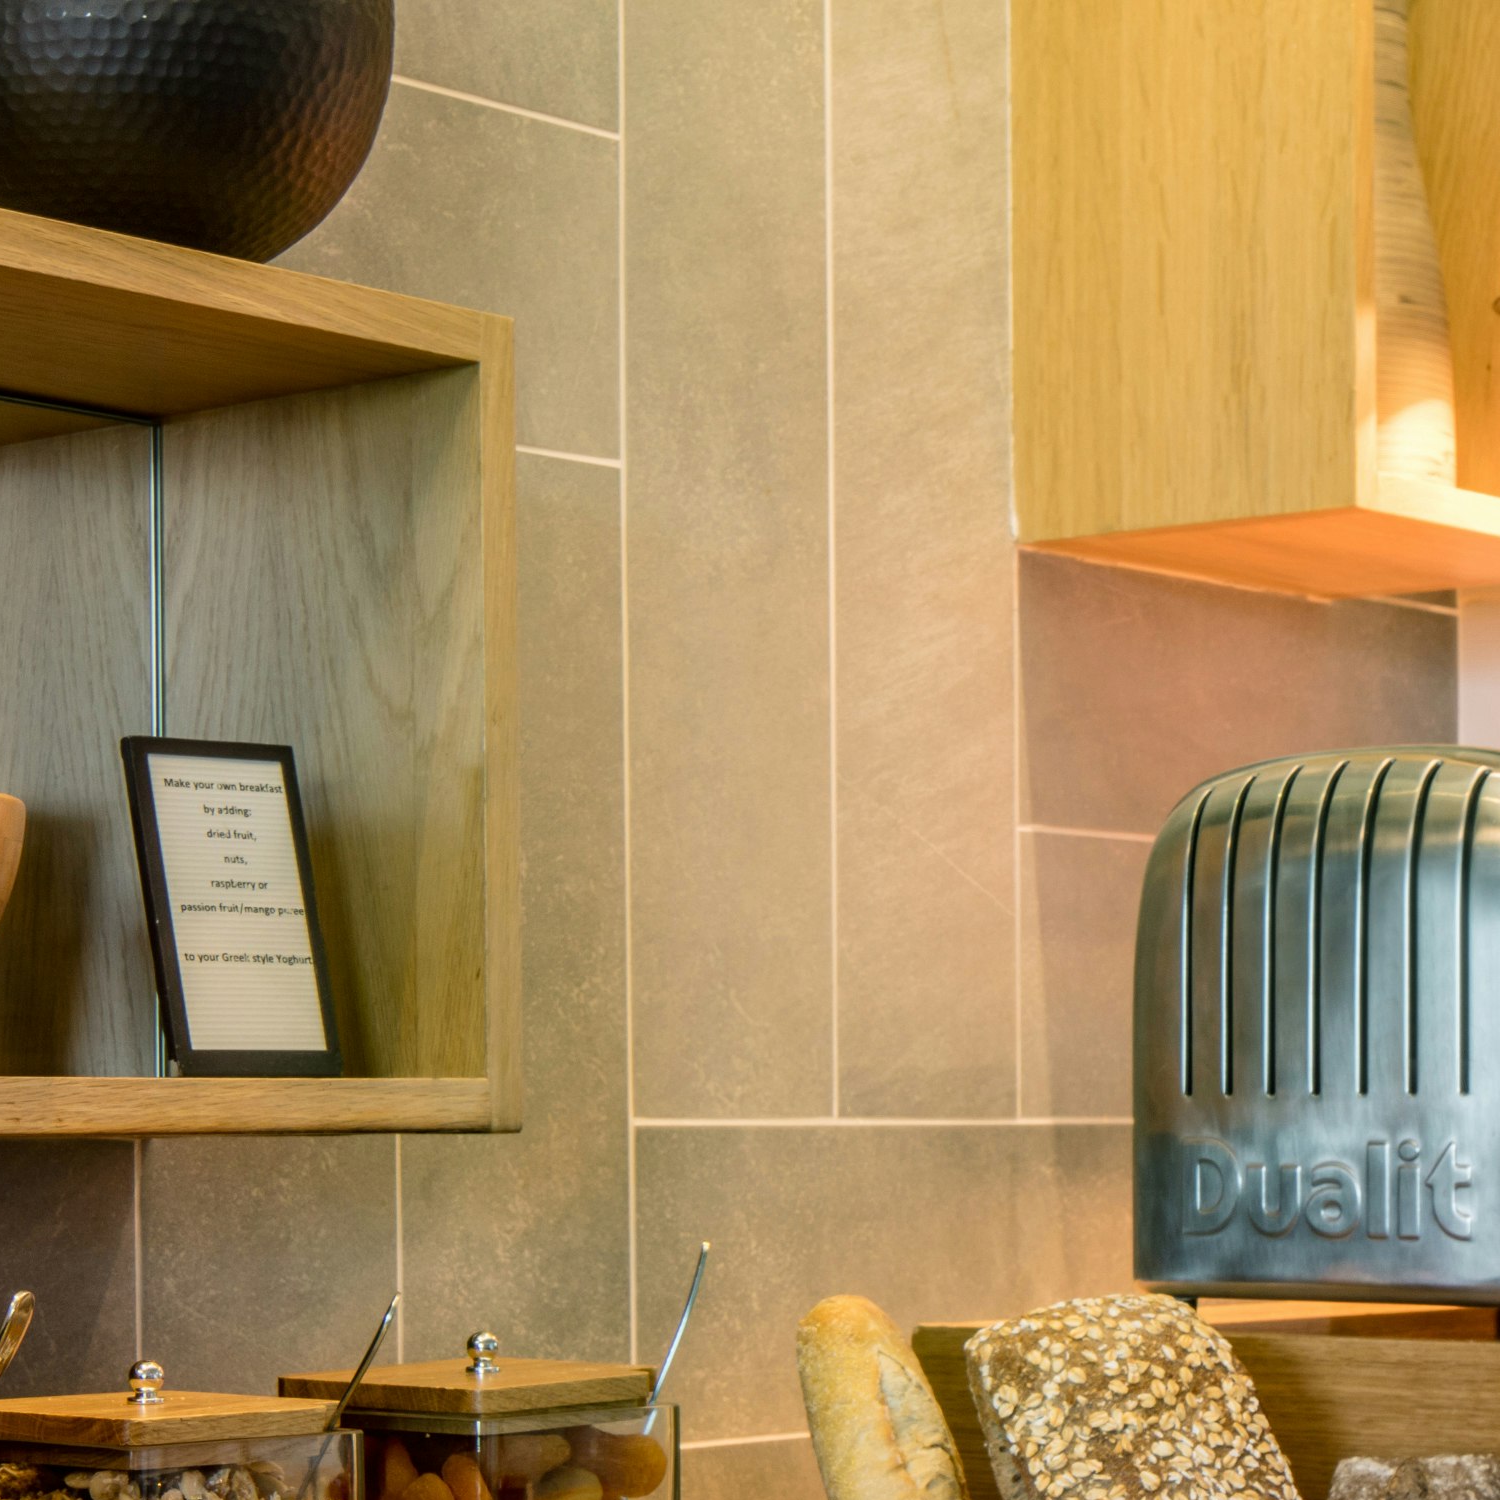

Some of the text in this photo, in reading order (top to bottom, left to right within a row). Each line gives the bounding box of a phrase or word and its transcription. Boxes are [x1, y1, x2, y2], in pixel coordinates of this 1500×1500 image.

[163, 778, 191, 788] Make
[193, 782, 214, 790] your
[239, 782, 283, 793] breakfast
[203, 805, 215, 816] by
[207, 829, 257, 841] dried fruit,
[224, 856, 248, 866] nuts,
[211, 879, 256, 890] raspberry
[181, 903, 305, 916] passion fruit/mango pee
[184, 953, 195, 961] to
[197, 954, 219, 963] your
[221, 952, 250, 962] Greek
[253, 954, 274, 964] style
[1182, 1137, 1476, 1245] Dualit
